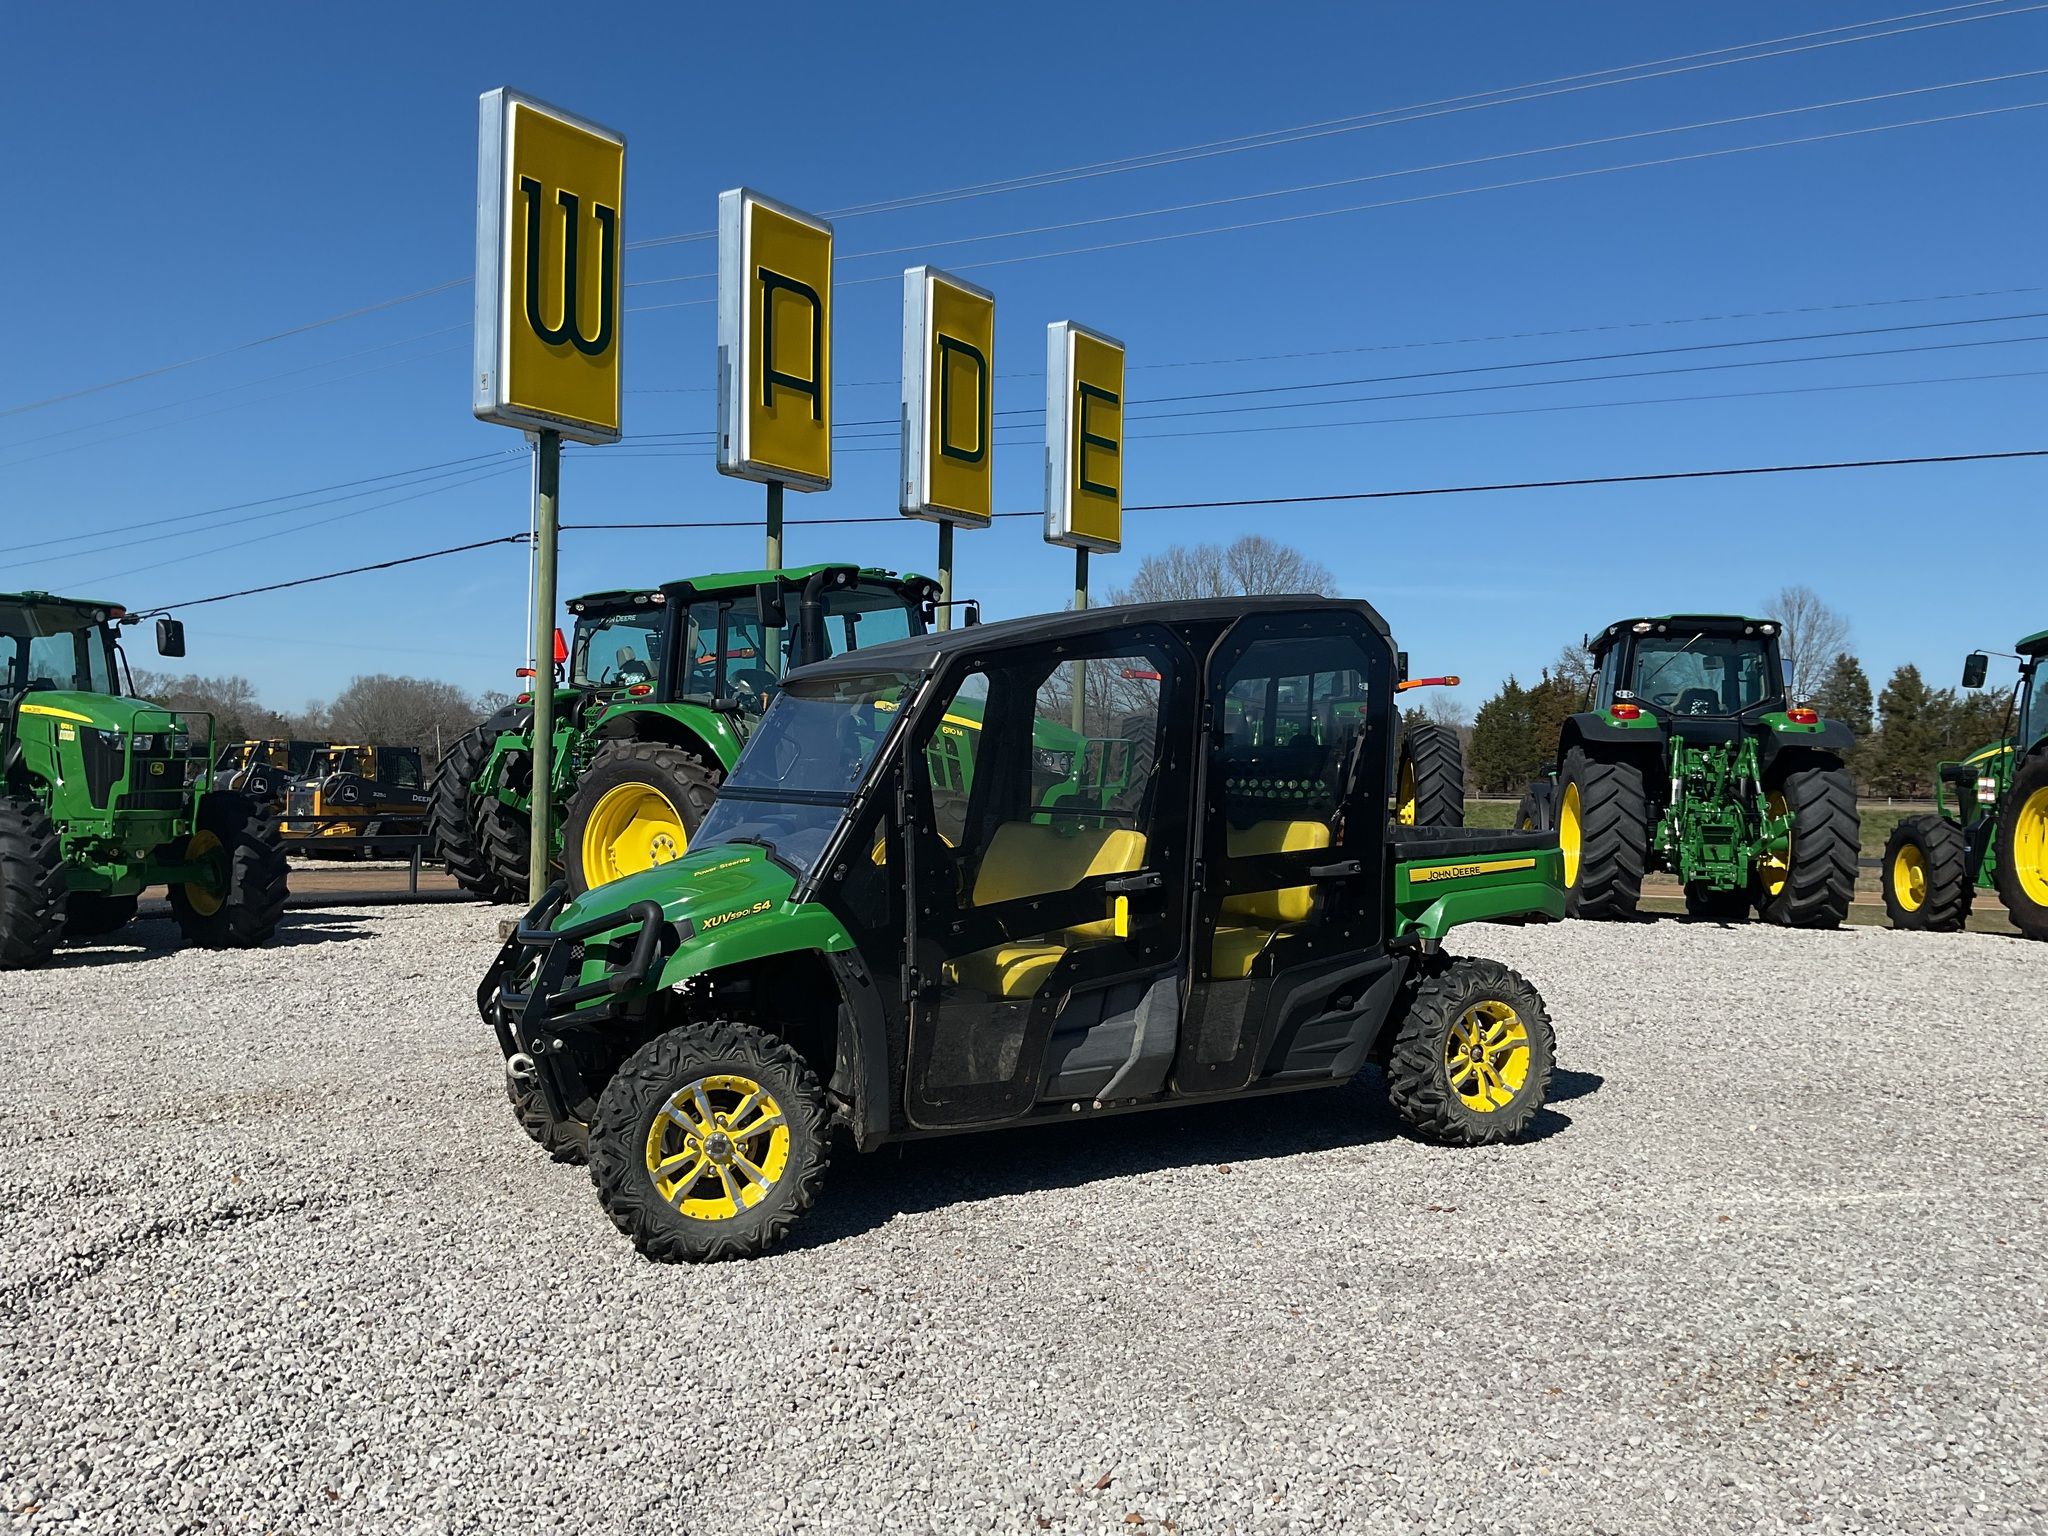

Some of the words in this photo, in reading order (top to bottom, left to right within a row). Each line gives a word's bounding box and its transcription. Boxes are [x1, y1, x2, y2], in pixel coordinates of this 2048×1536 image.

[615, 614, 637, 622] DEERE
[694, 867, 717, 877] Power
[719, 857, 751, 869] Steering
[1427, 870, 1451, 879] JOHN
[1452, 866, 1480, 877] DEERE
[752, 900, 771, 914] S4
